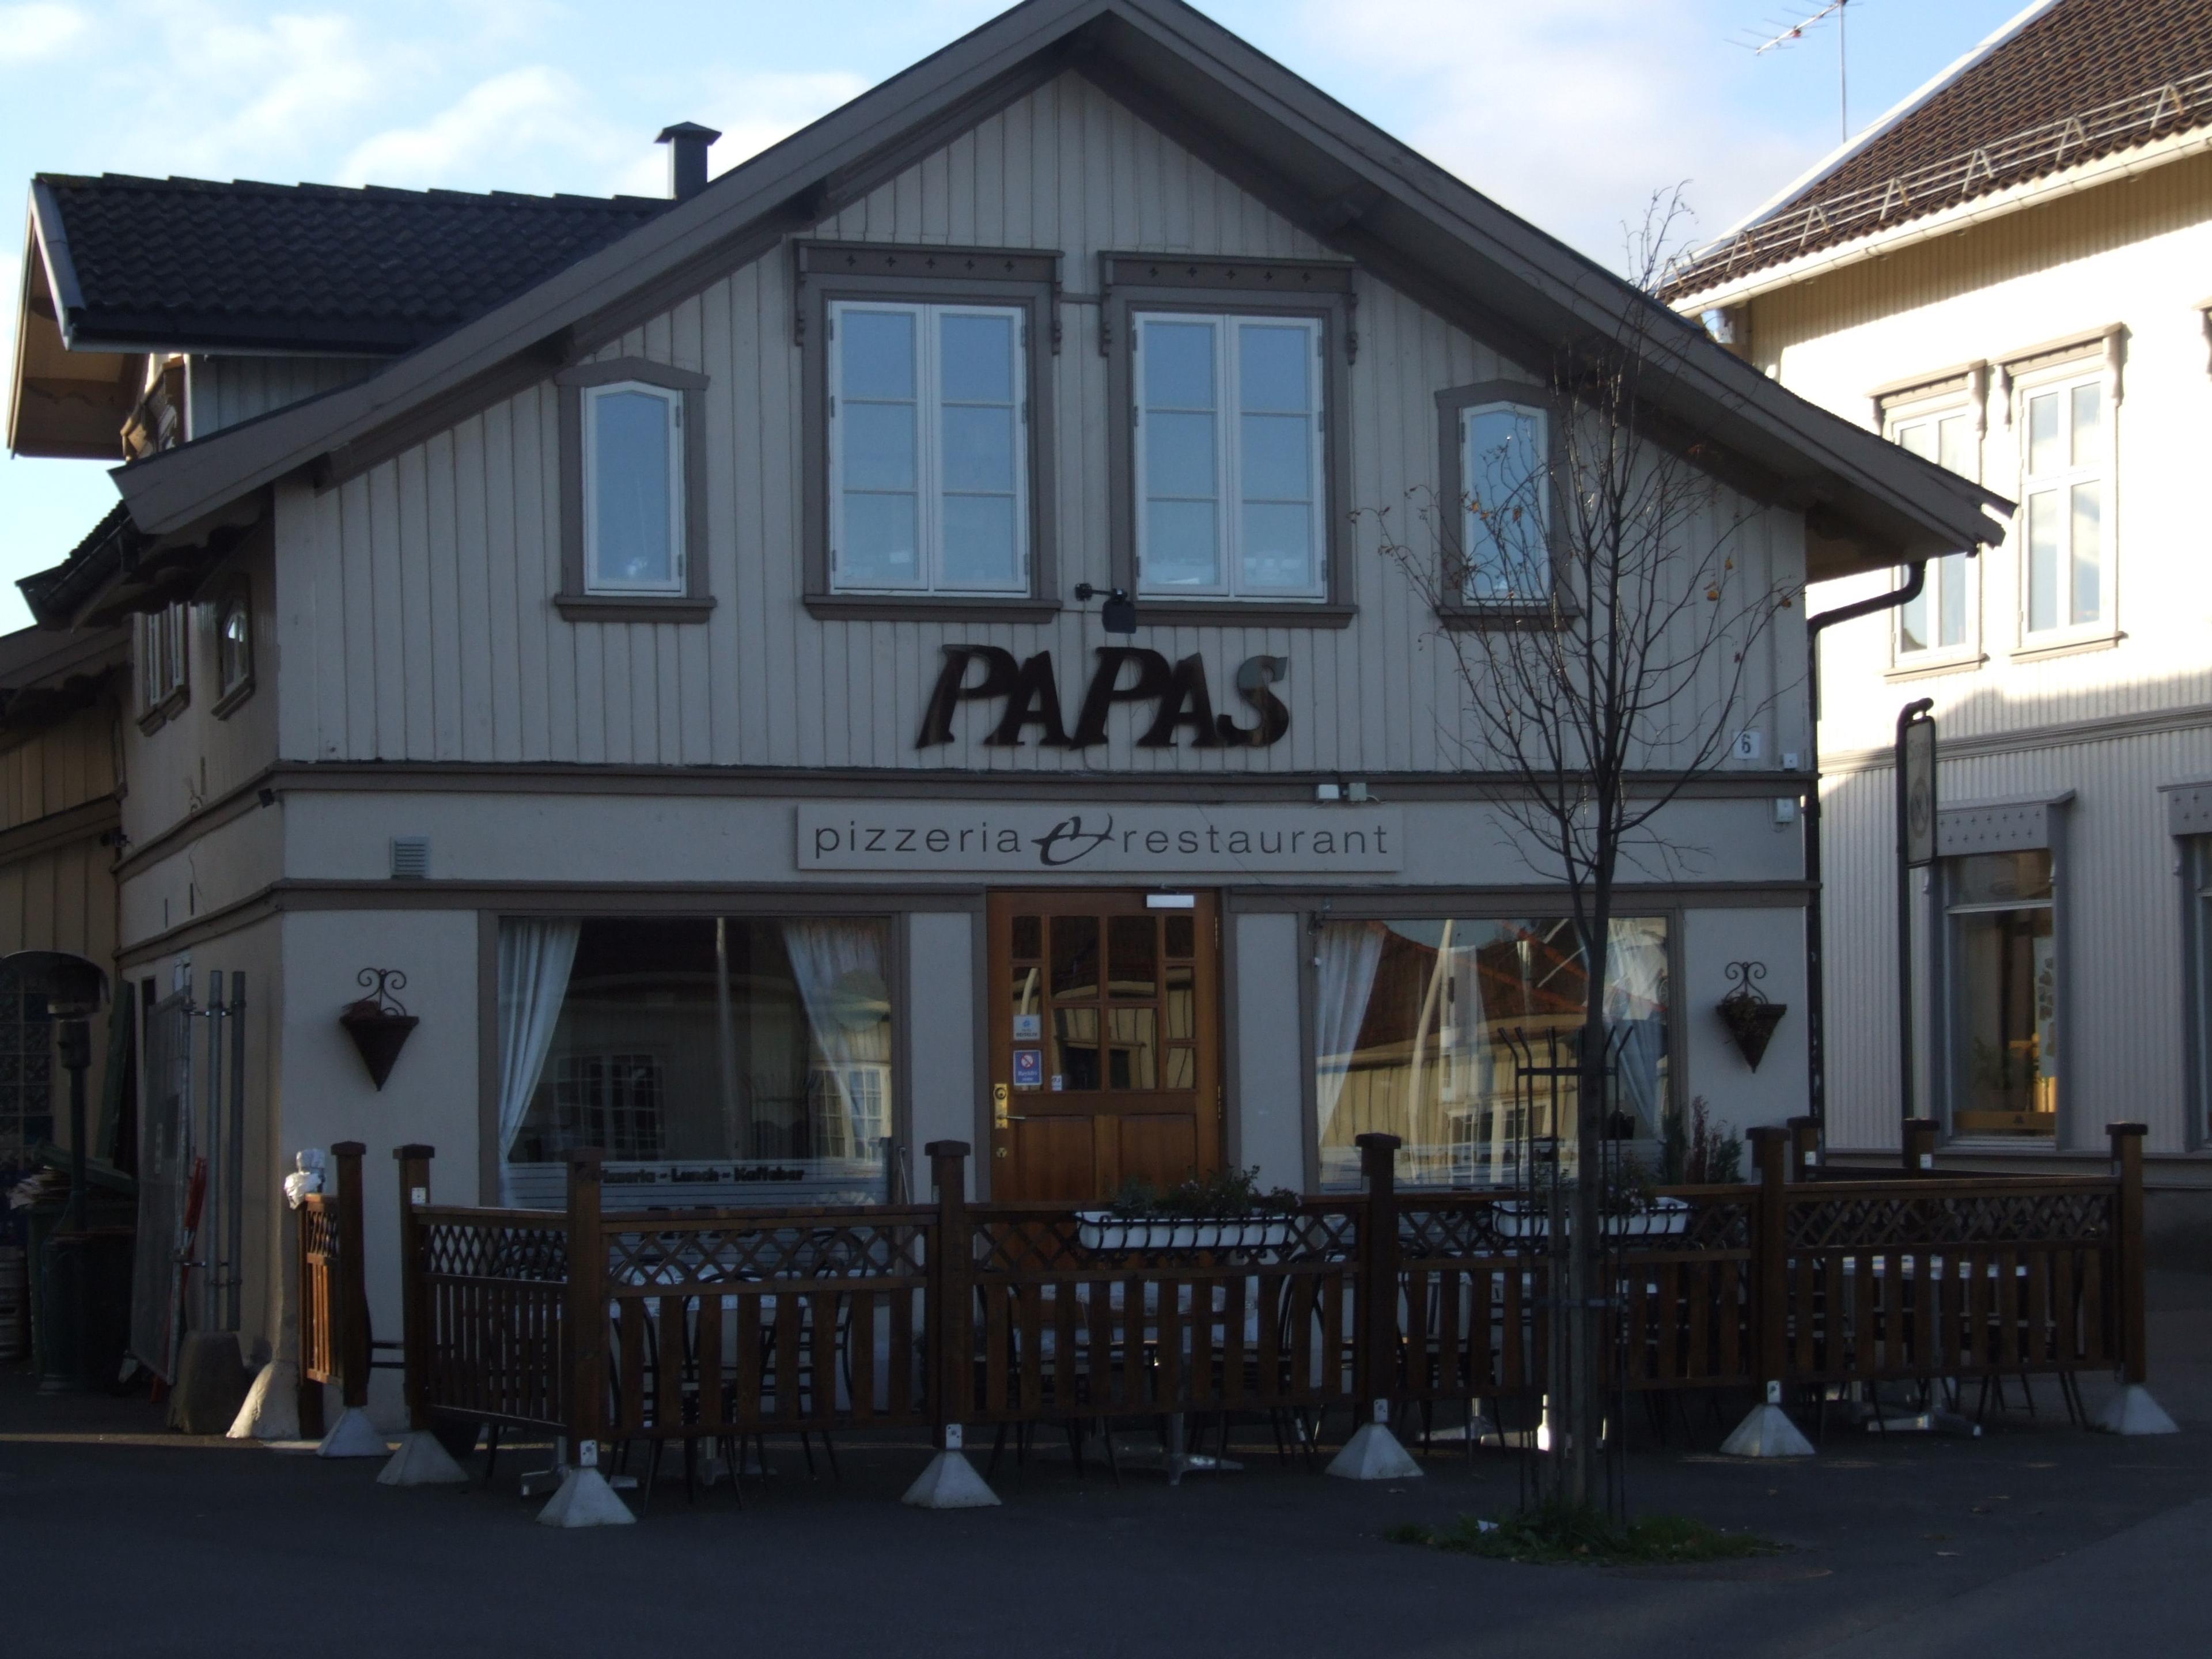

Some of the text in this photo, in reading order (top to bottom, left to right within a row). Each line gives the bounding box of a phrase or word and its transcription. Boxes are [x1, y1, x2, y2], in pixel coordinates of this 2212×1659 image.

[916, 643, 1289, 750] PAPAS
[815, 820, 1021, 859] pizzeria
[1123, 825, 1387, 854] restaurant
